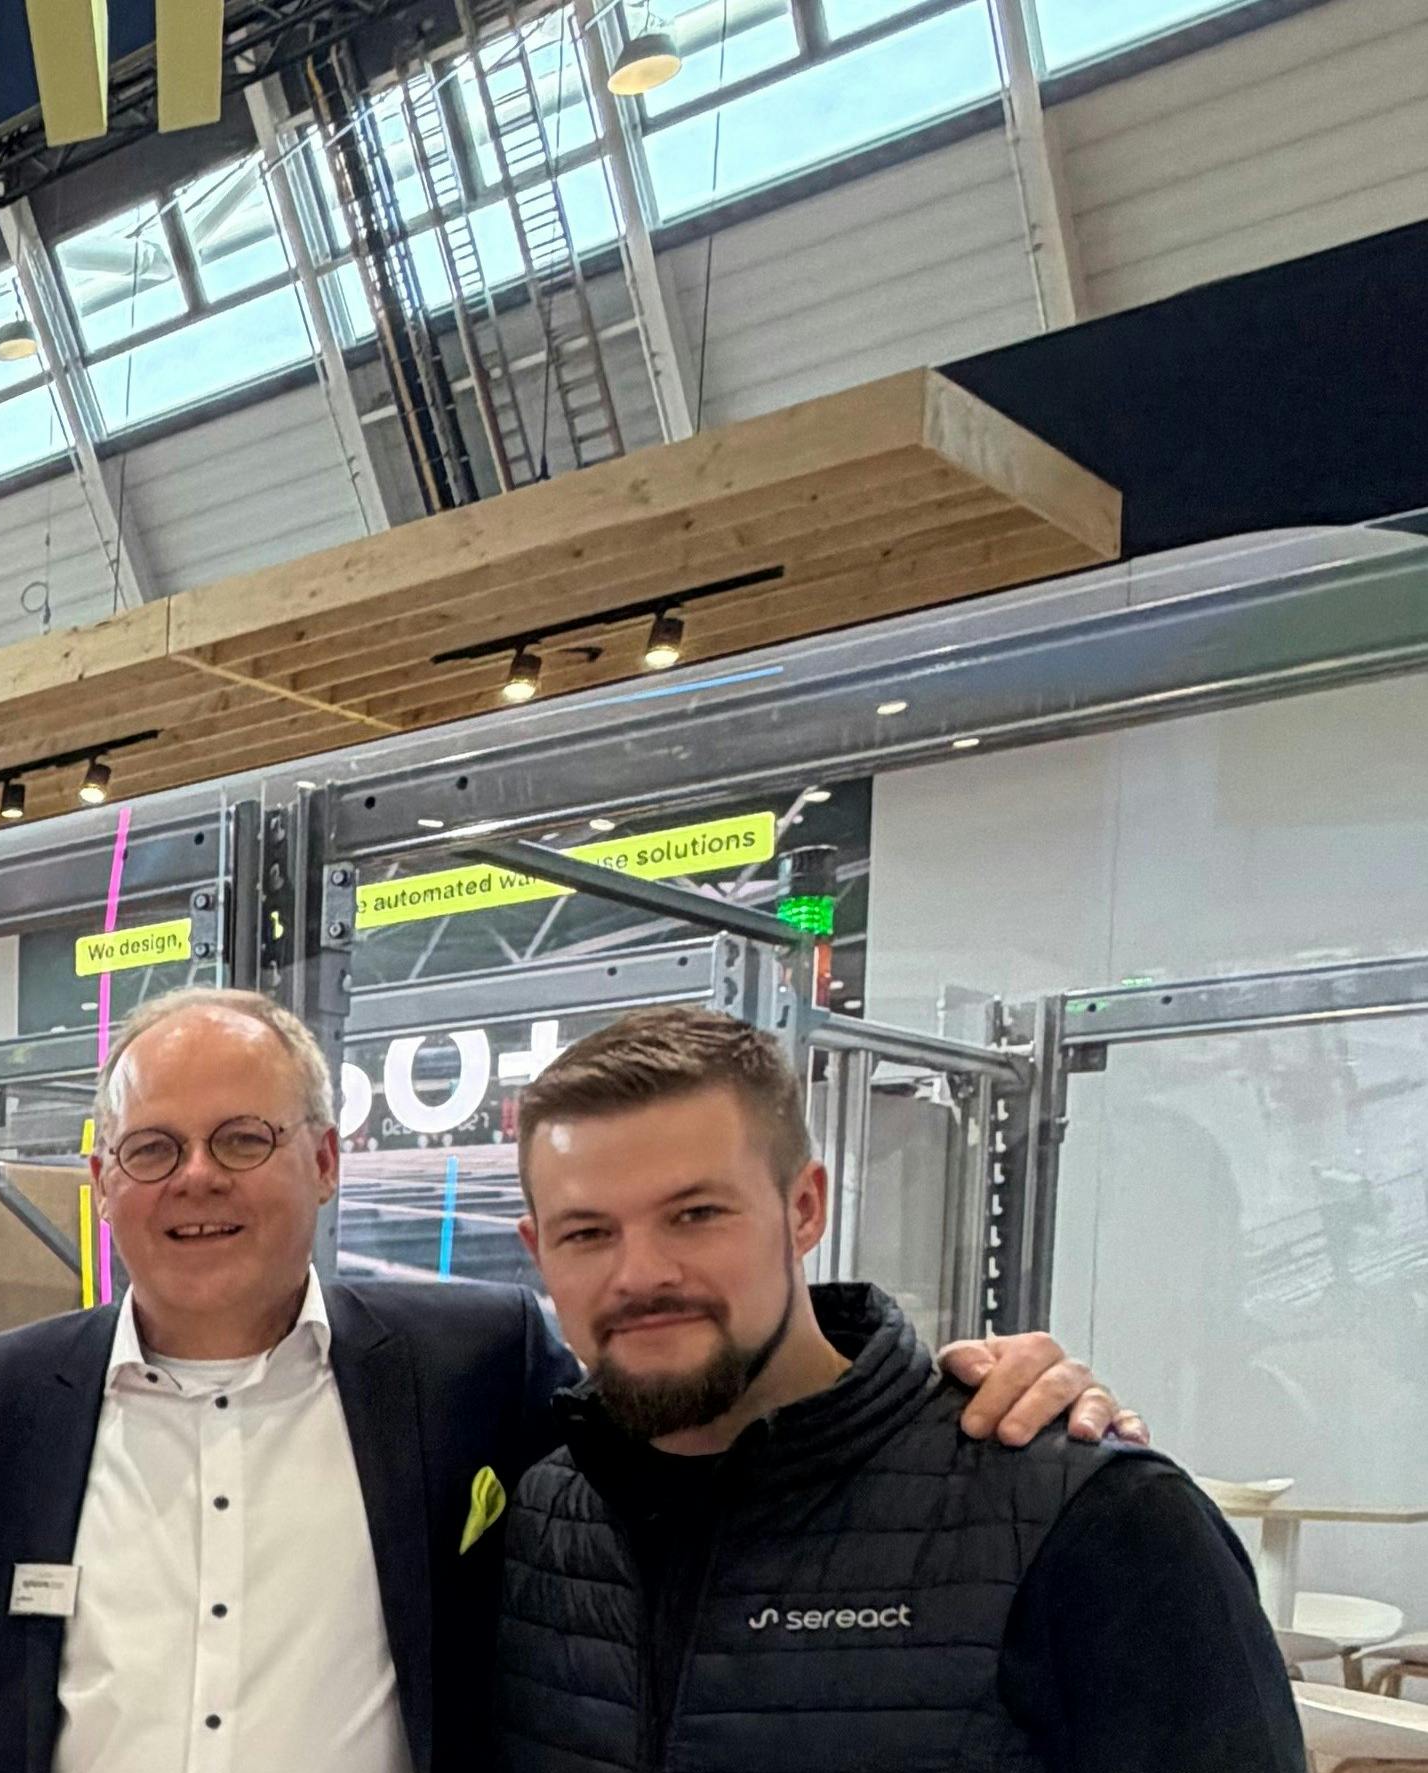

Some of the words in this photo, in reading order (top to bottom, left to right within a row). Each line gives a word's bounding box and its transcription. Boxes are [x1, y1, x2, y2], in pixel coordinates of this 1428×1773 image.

[374, 873, 492, 911] automated
[636, 831, 756, 866] solutions
[119, 933, 183, 956] design,
[785, 1603, 912, 1630] sereact
